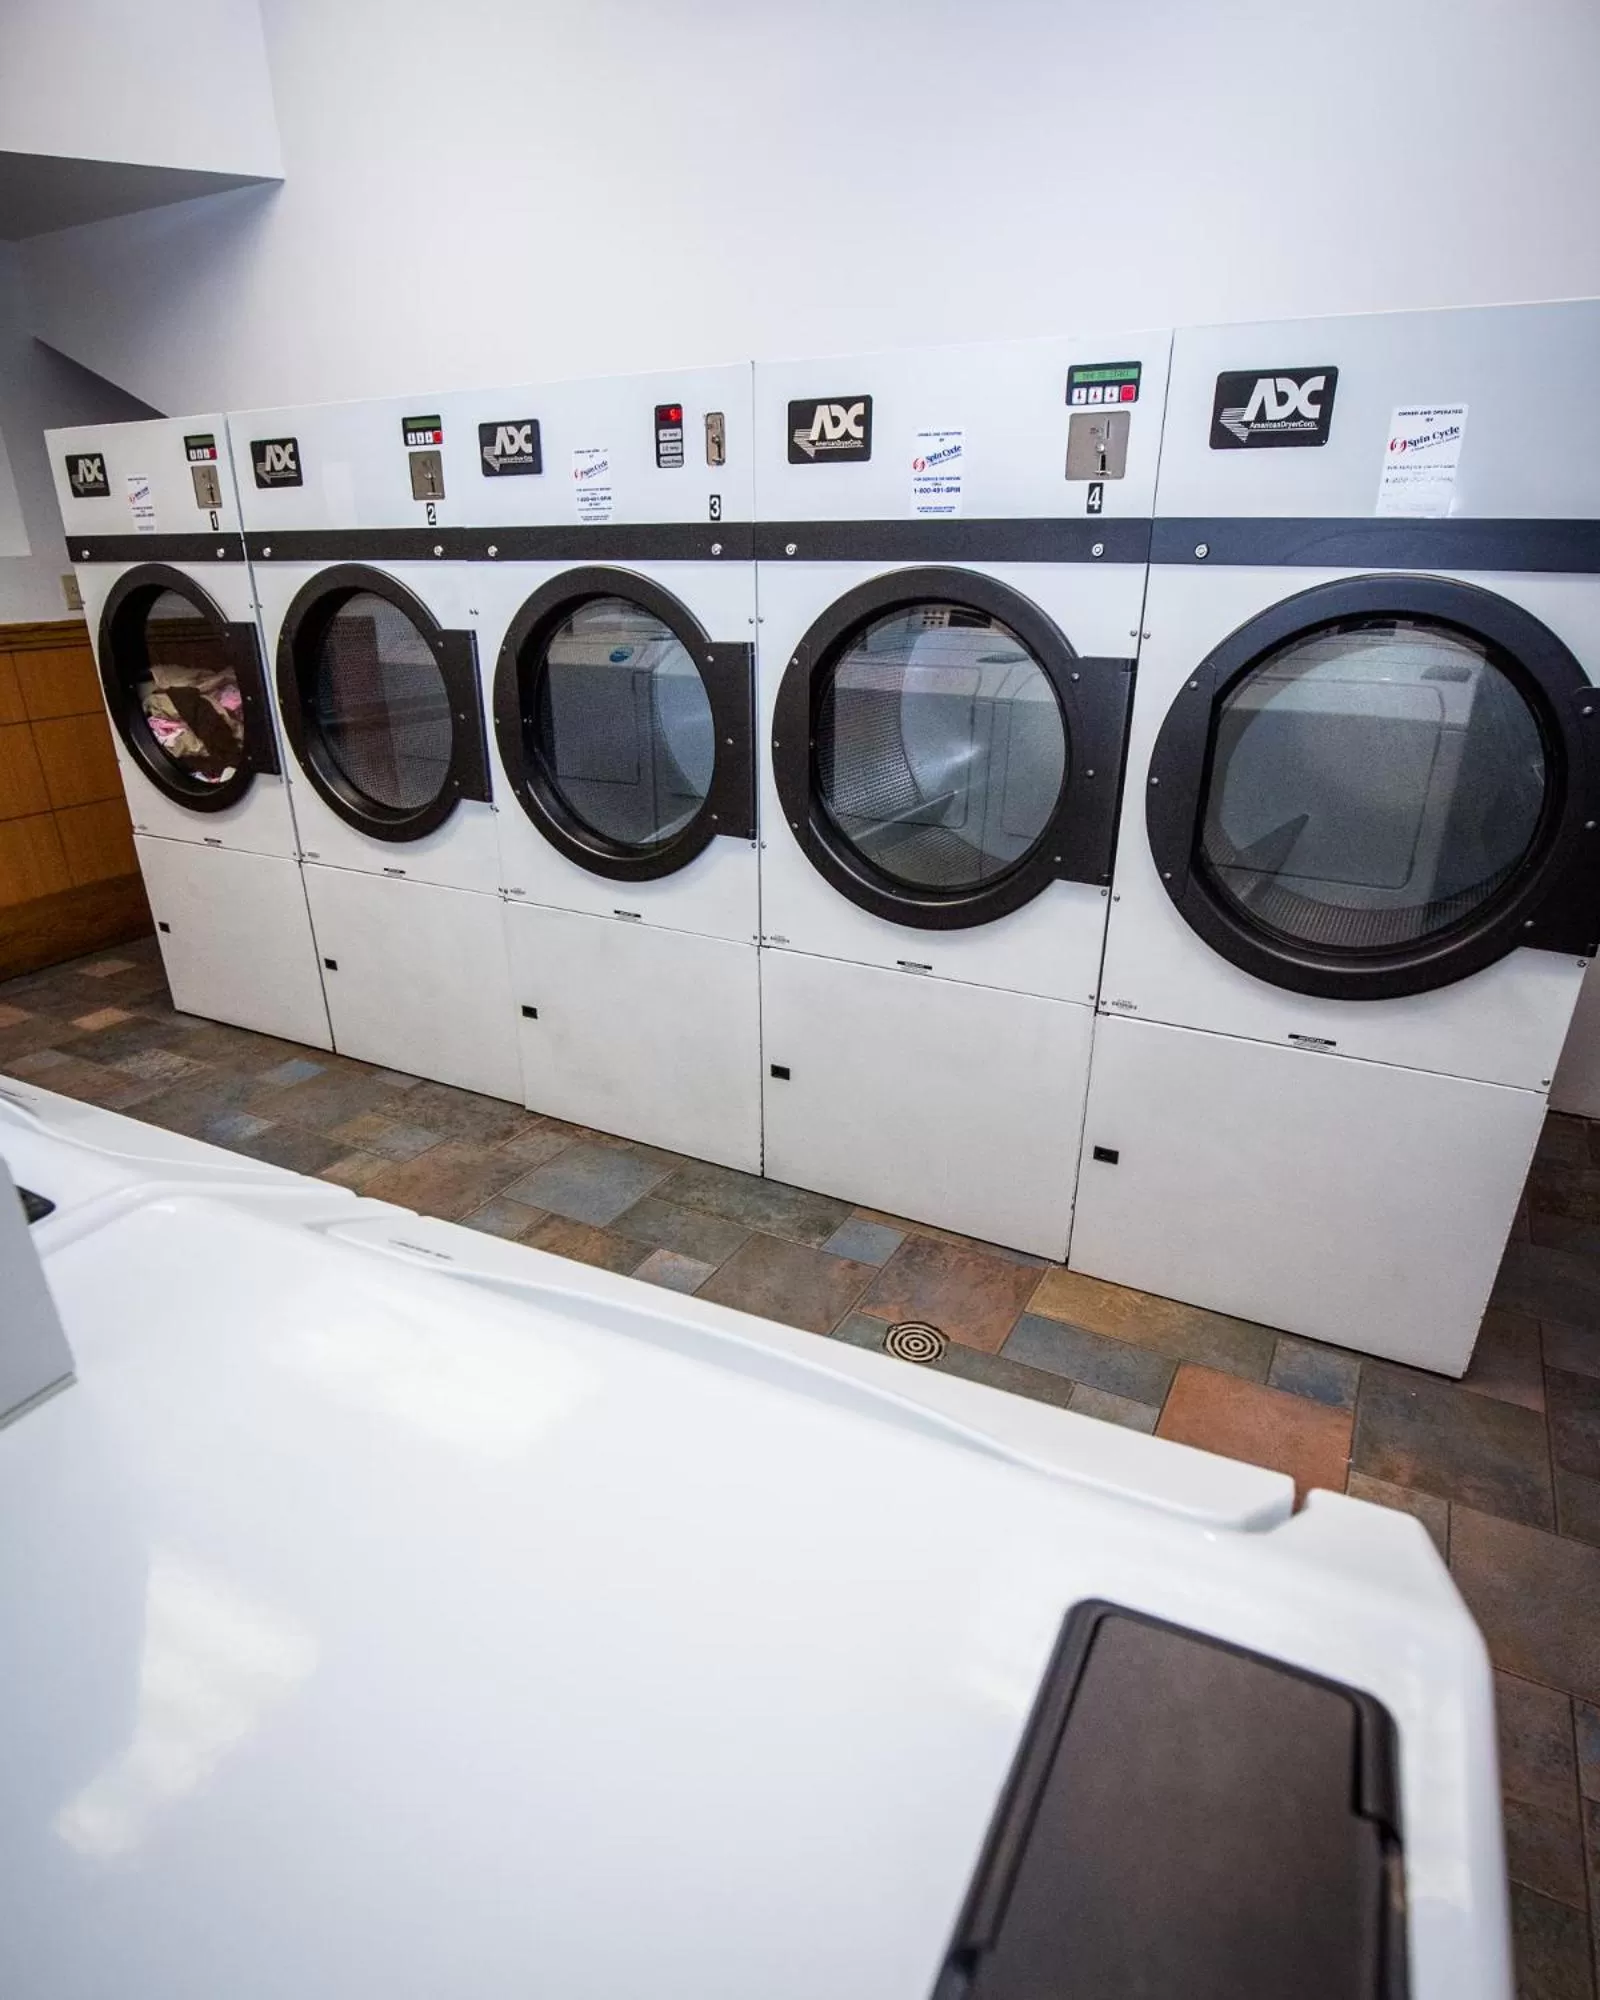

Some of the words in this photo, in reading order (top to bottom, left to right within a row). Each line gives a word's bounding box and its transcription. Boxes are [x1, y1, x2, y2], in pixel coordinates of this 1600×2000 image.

[1242, 375, 1326, 421] ADC
[809, 402, 864, 441] ADC
[494, 424, 533, 455] ADC
[1407, 435, 1431, 447] Spin
[1432, 426, 1460, 440] Cycle
[265, 443, 297, 471] ADC
[925, 451, 942, 463] Spin
[942, 445, 962, 456] Cycle
[78, 458, 104, 482] ADC
[711, 497, 720, 517] 3
[1088, 486, 1101, 510] 4
[211, 512, 218, 528] 1
[427, 505, 436, 522] 2
